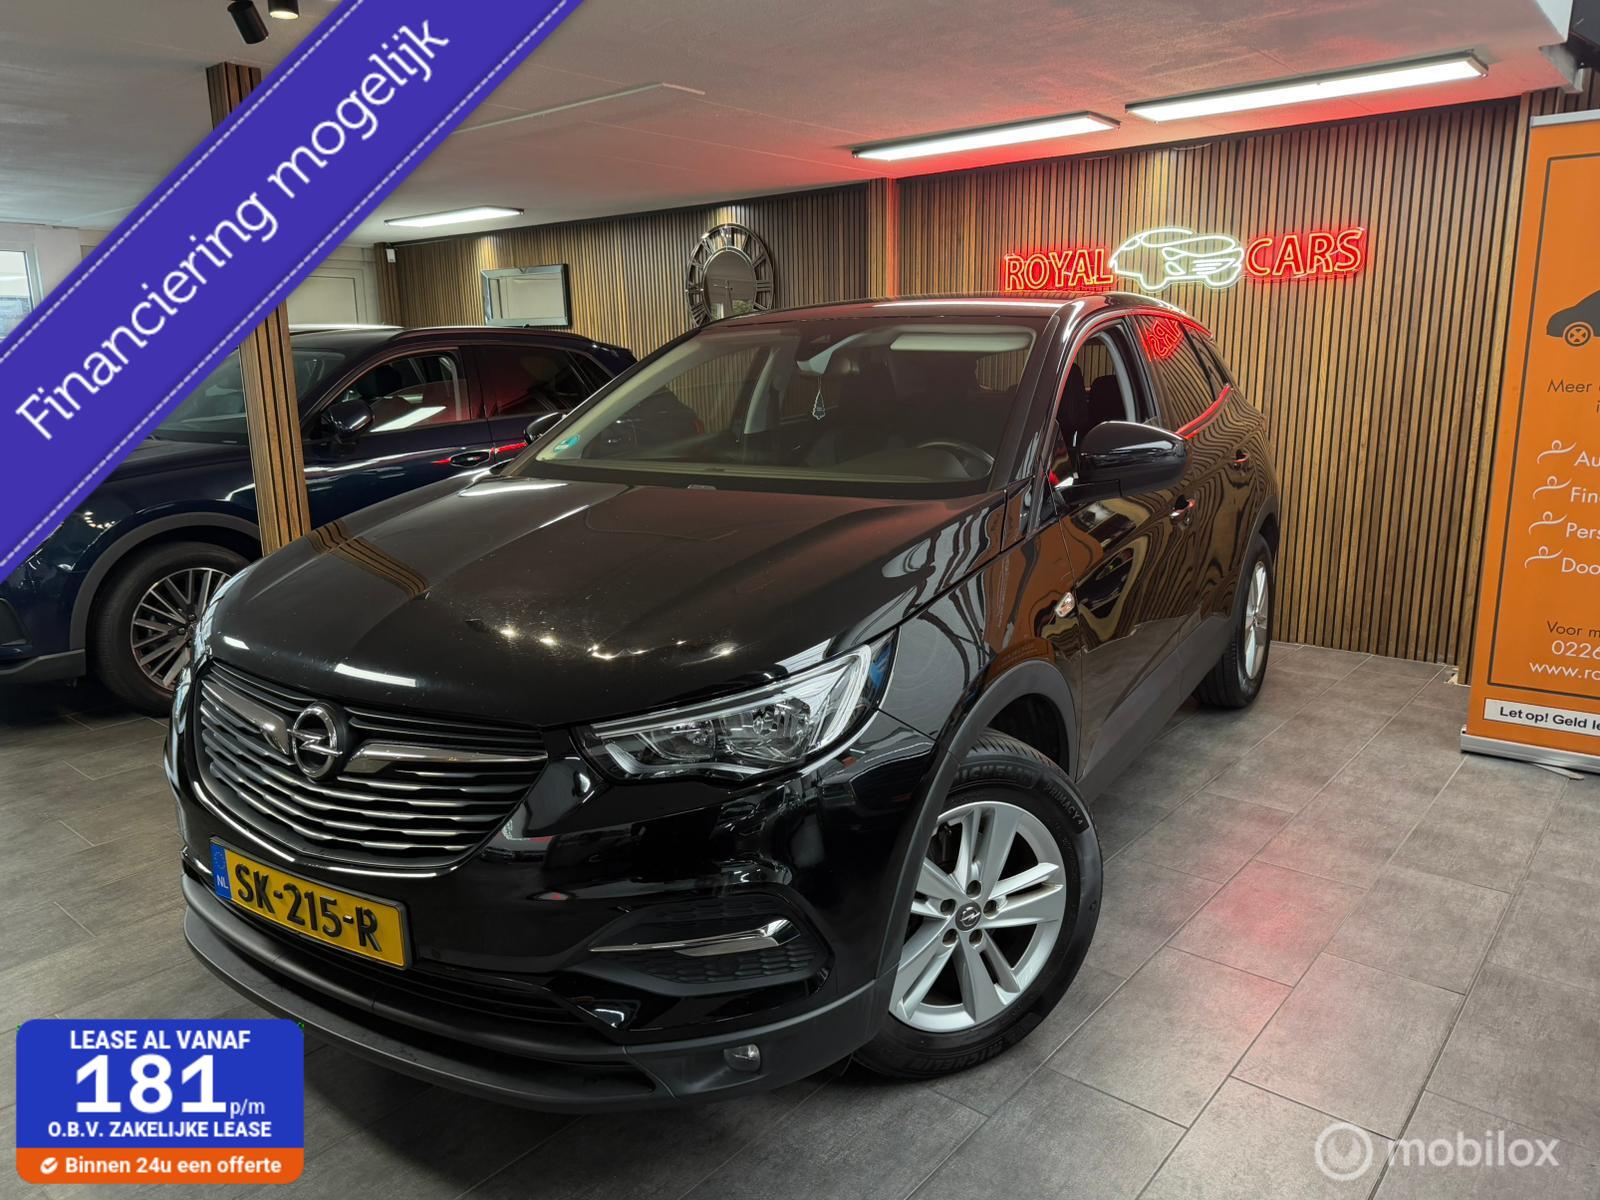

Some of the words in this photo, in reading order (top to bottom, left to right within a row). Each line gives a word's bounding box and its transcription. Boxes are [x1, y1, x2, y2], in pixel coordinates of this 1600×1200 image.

[1004, 248, 1114, 291] ROYAL
[1246, 228, 1365, 277] CARS
[1547, 379, 1592, 393] Meer
[1574, 451, 1600, 467] Au
[1562, 557, 1600, 575] Doo
[1547, 620, 1582, 636] Voor
[1500, 706, 1523, 719] Let
[1525, 713, 1549, 724] op!
[1553, 714, 1587, 729] Geld
[216, 875, 229, 889] NL
[235, 863, 382, 952] SK-215-R
